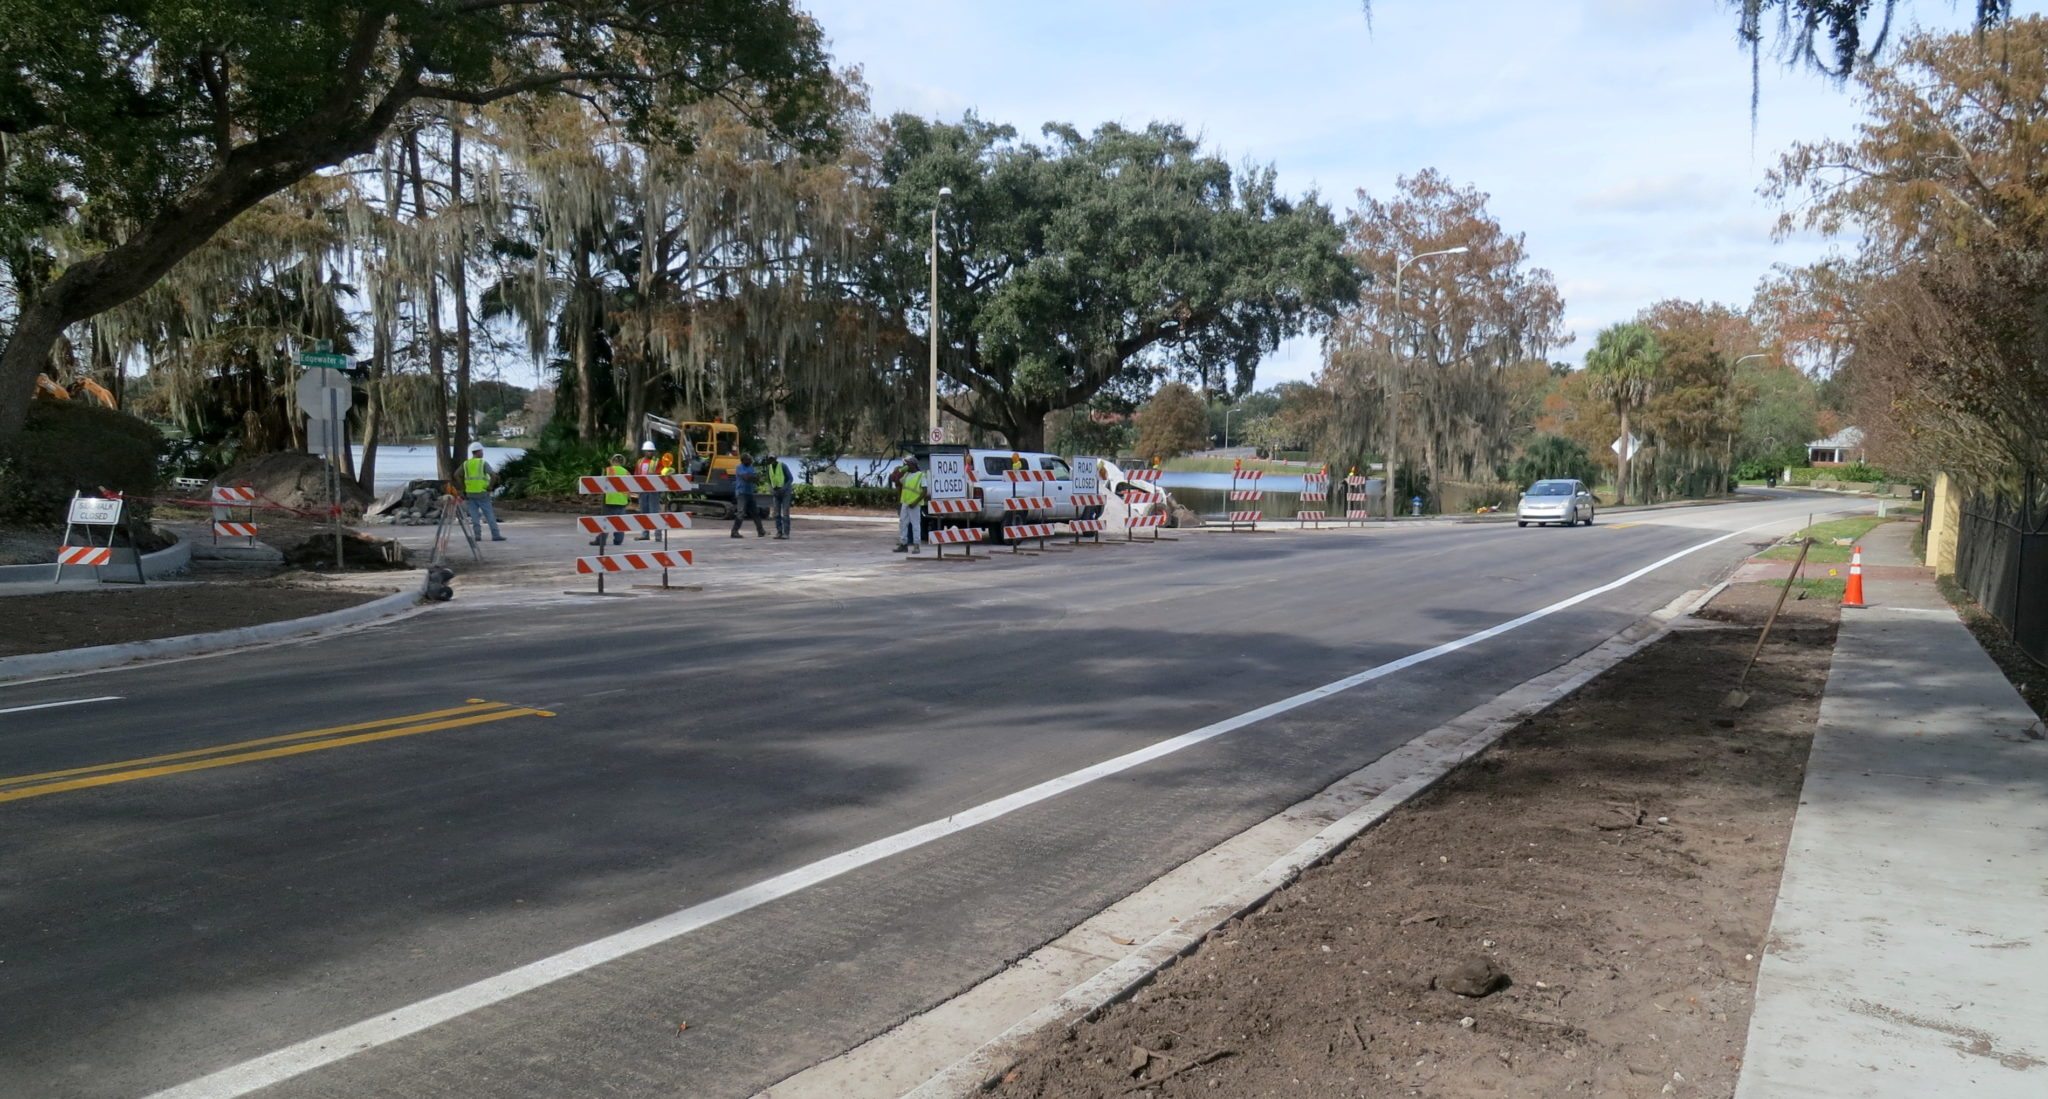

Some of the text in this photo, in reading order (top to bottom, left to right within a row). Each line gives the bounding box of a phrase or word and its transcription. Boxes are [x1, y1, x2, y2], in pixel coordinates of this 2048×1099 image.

[300, 354, 337, 364] Edgewater
[937, 461, 958, 474] ROAD
[1078, 461, 1093, 473] ROAD
[934, 479, 963, 493] CLOSED
[1074, 477, 1095, 489] CLOSED
[80, 512, 108, 520] CLOSED
